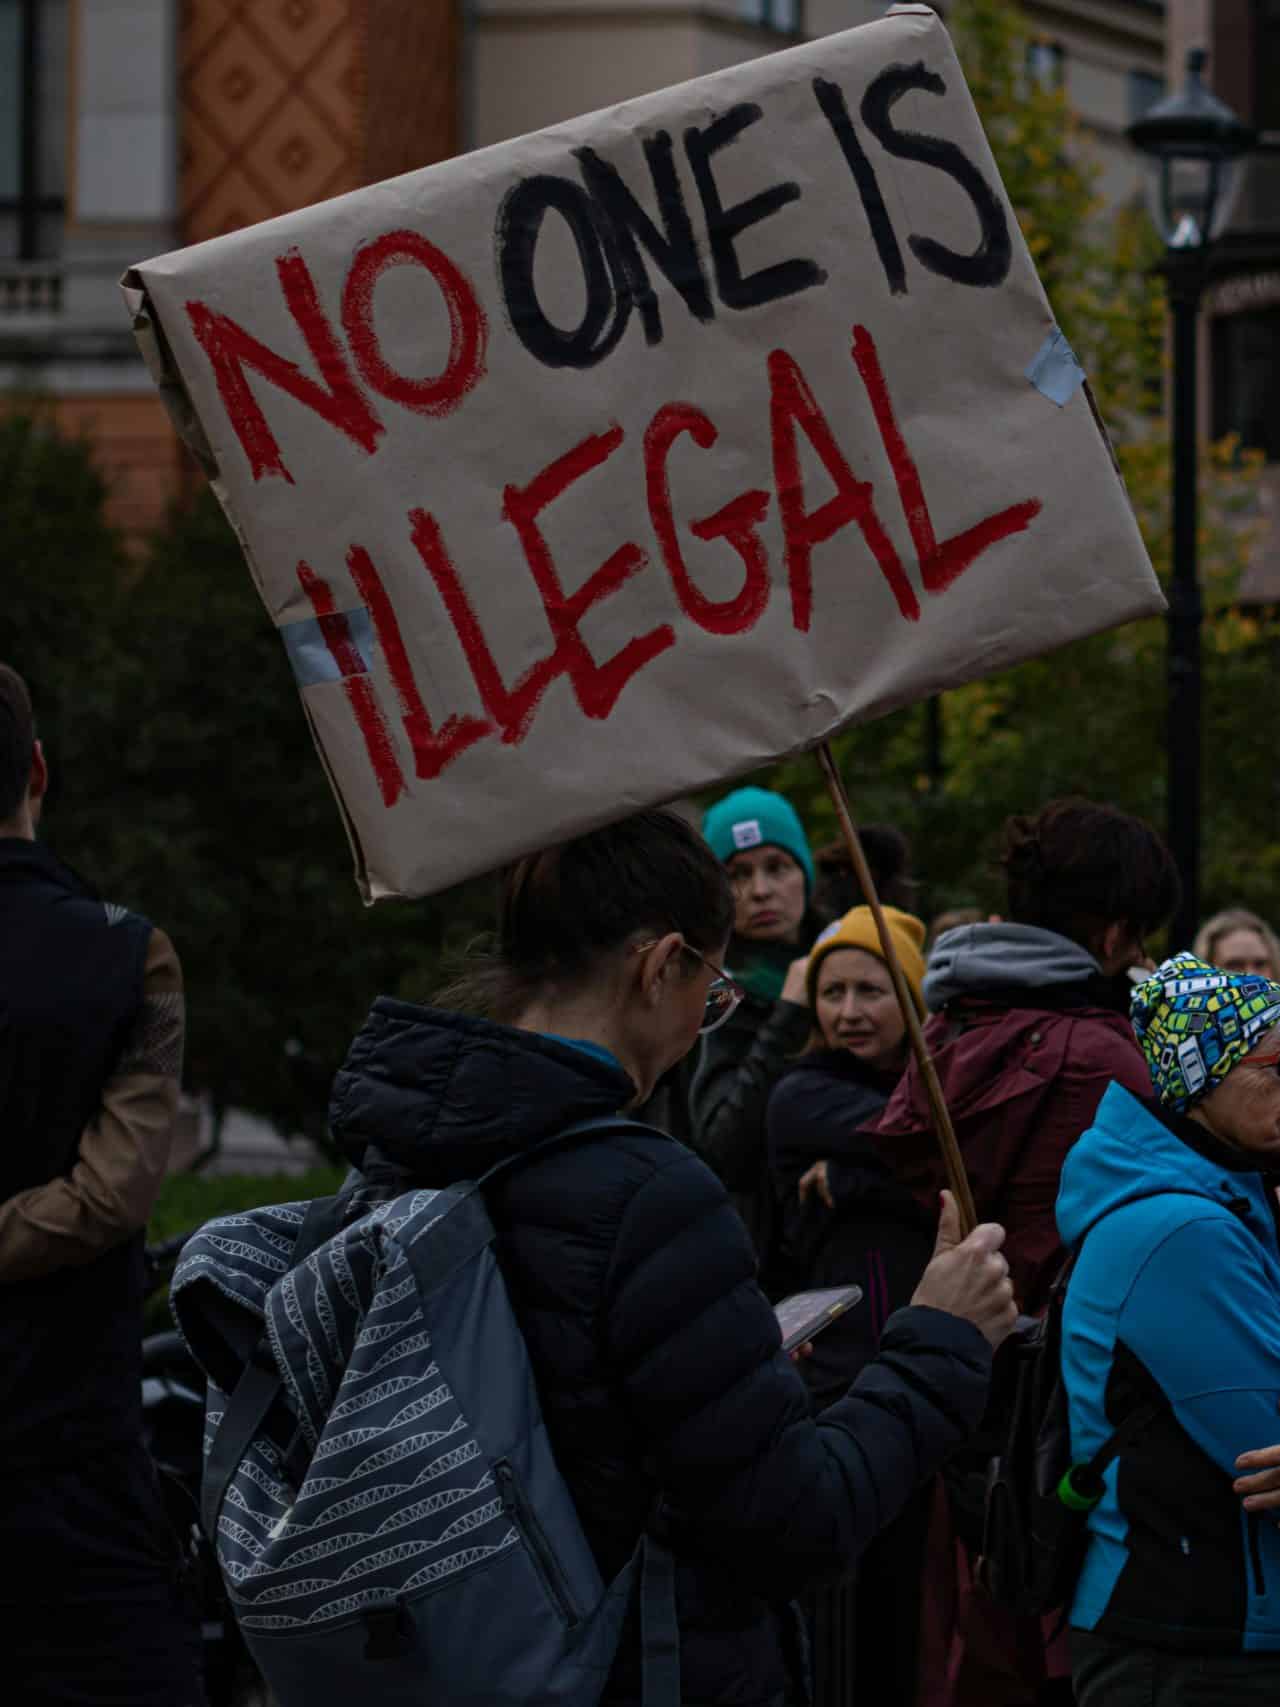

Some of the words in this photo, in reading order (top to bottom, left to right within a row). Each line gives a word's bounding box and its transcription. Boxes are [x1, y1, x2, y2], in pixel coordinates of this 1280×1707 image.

[183, 228, 489, 485] NO
[494, 103, 828, 370] ONE
[812, 60, 1012, 296] IS
[296, 324, 1043, 808] ILLEGAL
